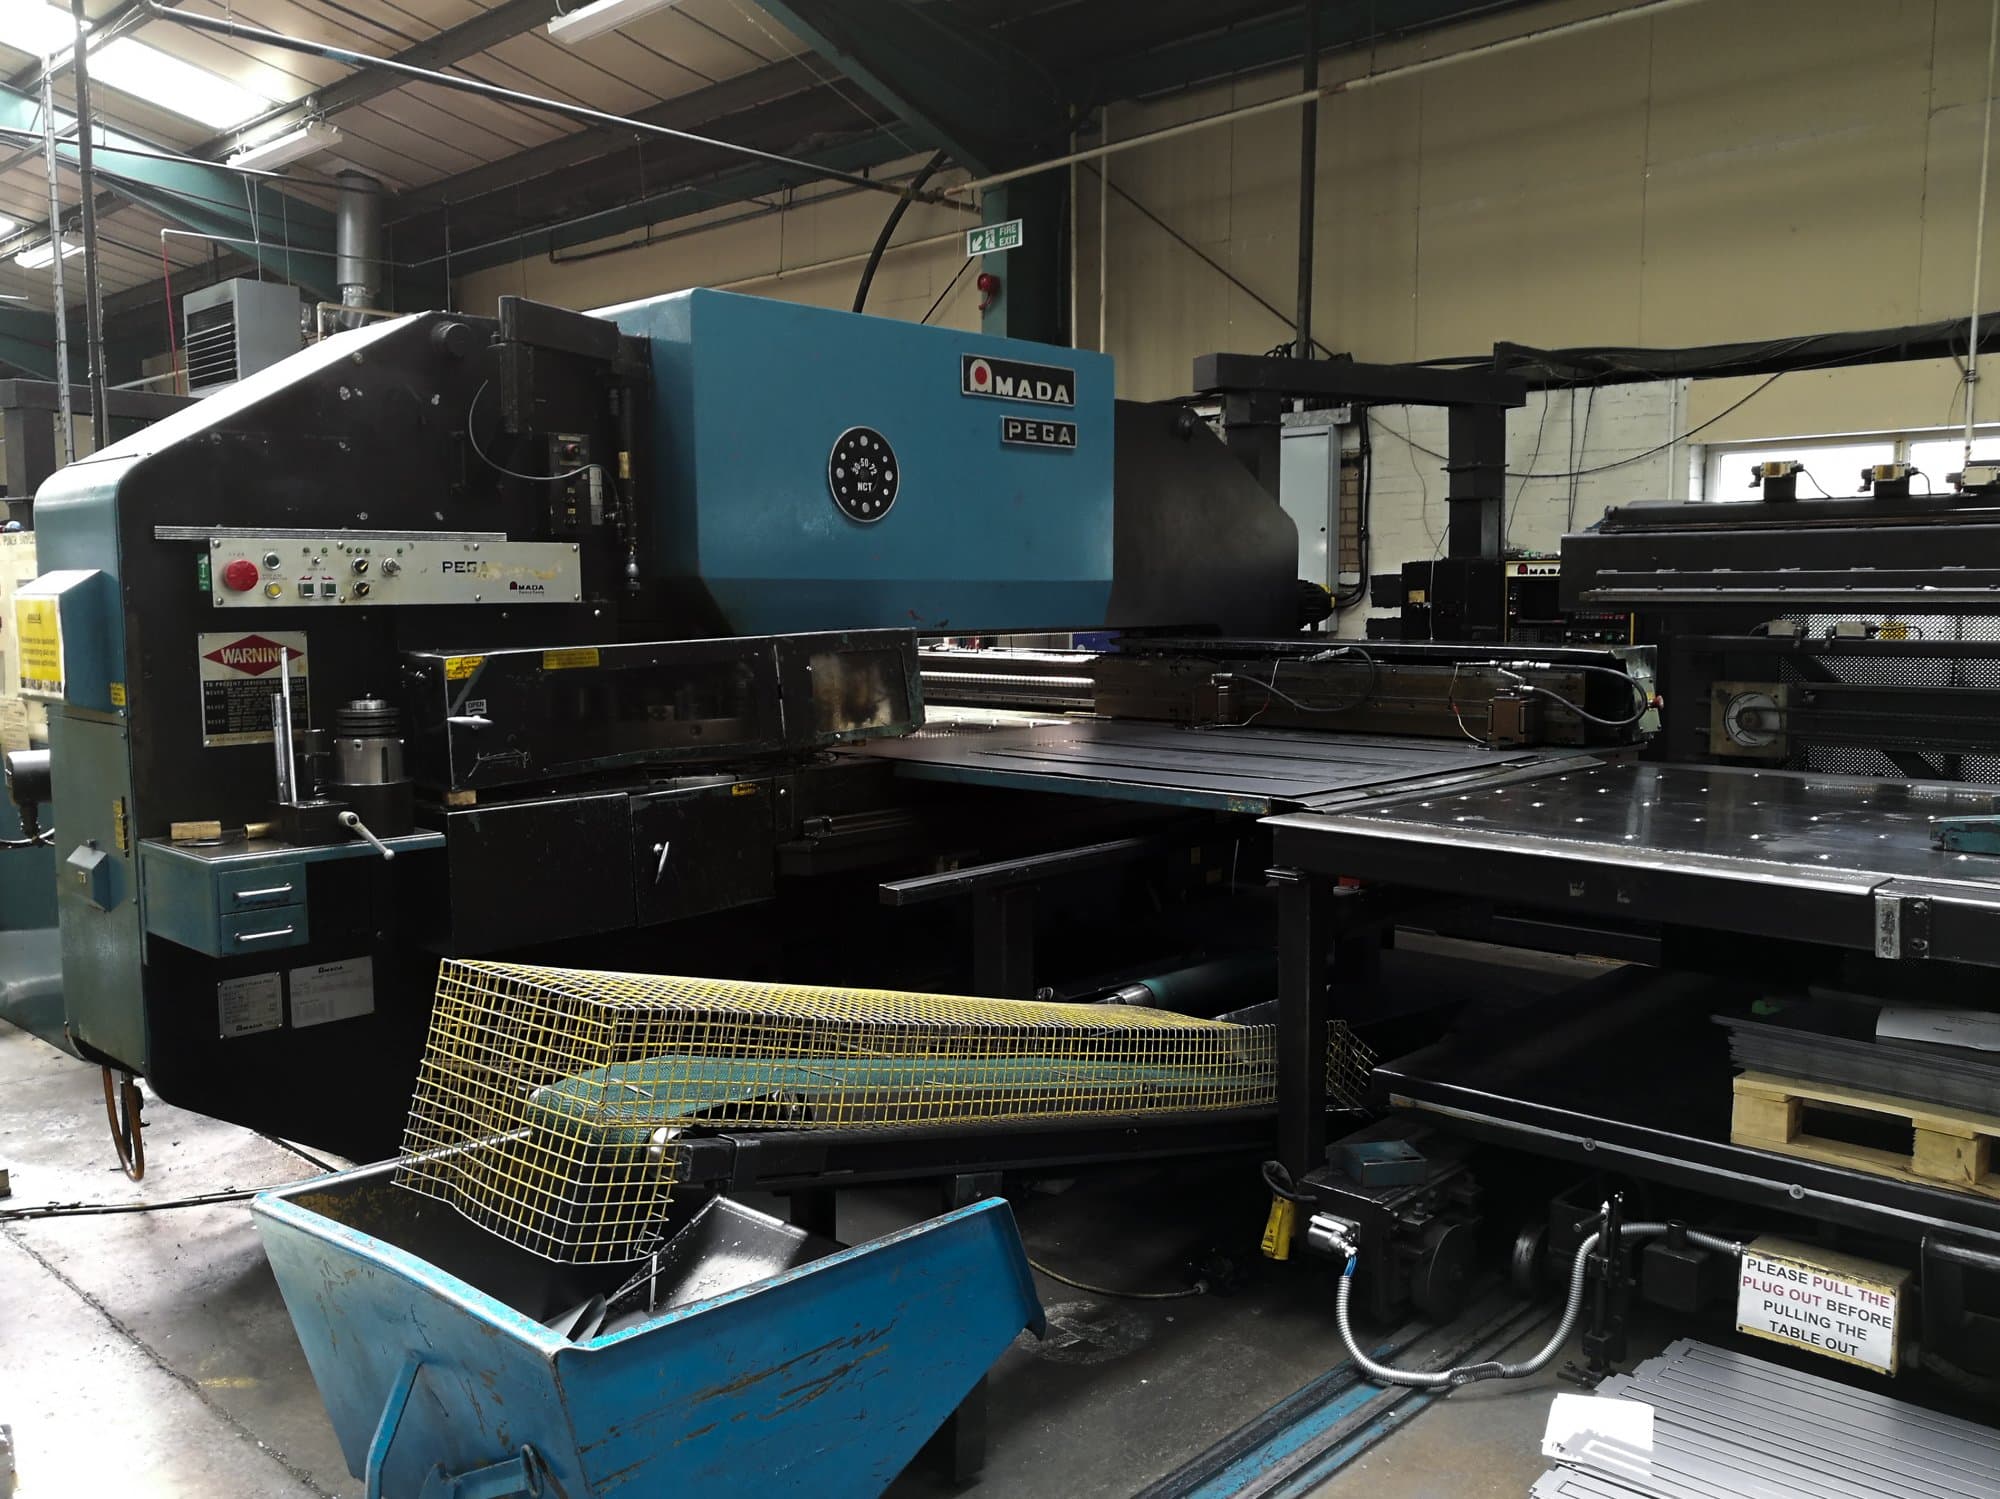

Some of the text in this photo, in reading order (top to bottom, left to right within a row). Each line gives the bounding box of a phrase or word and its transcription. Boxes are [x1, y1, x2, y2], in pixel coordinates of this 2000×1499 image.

[1000, 224, 1017, 235] FIRE
[1000, 235, 1017, 247] EXIT
[1009, 421, 1071, 444] PEGA
[857, 482, 873, 492] NCT
[467, 701, 485, 709] OPEN
[1747, 1258, 1890, 1309] PLEASE PULL THE
[1742, 1275, 1892, 1330] PLUG OUT BEFORE
[1763, 1300, 1868, 1341] PULLING THE
[1769, 1320, 1859, 1357] TABLE OUT
